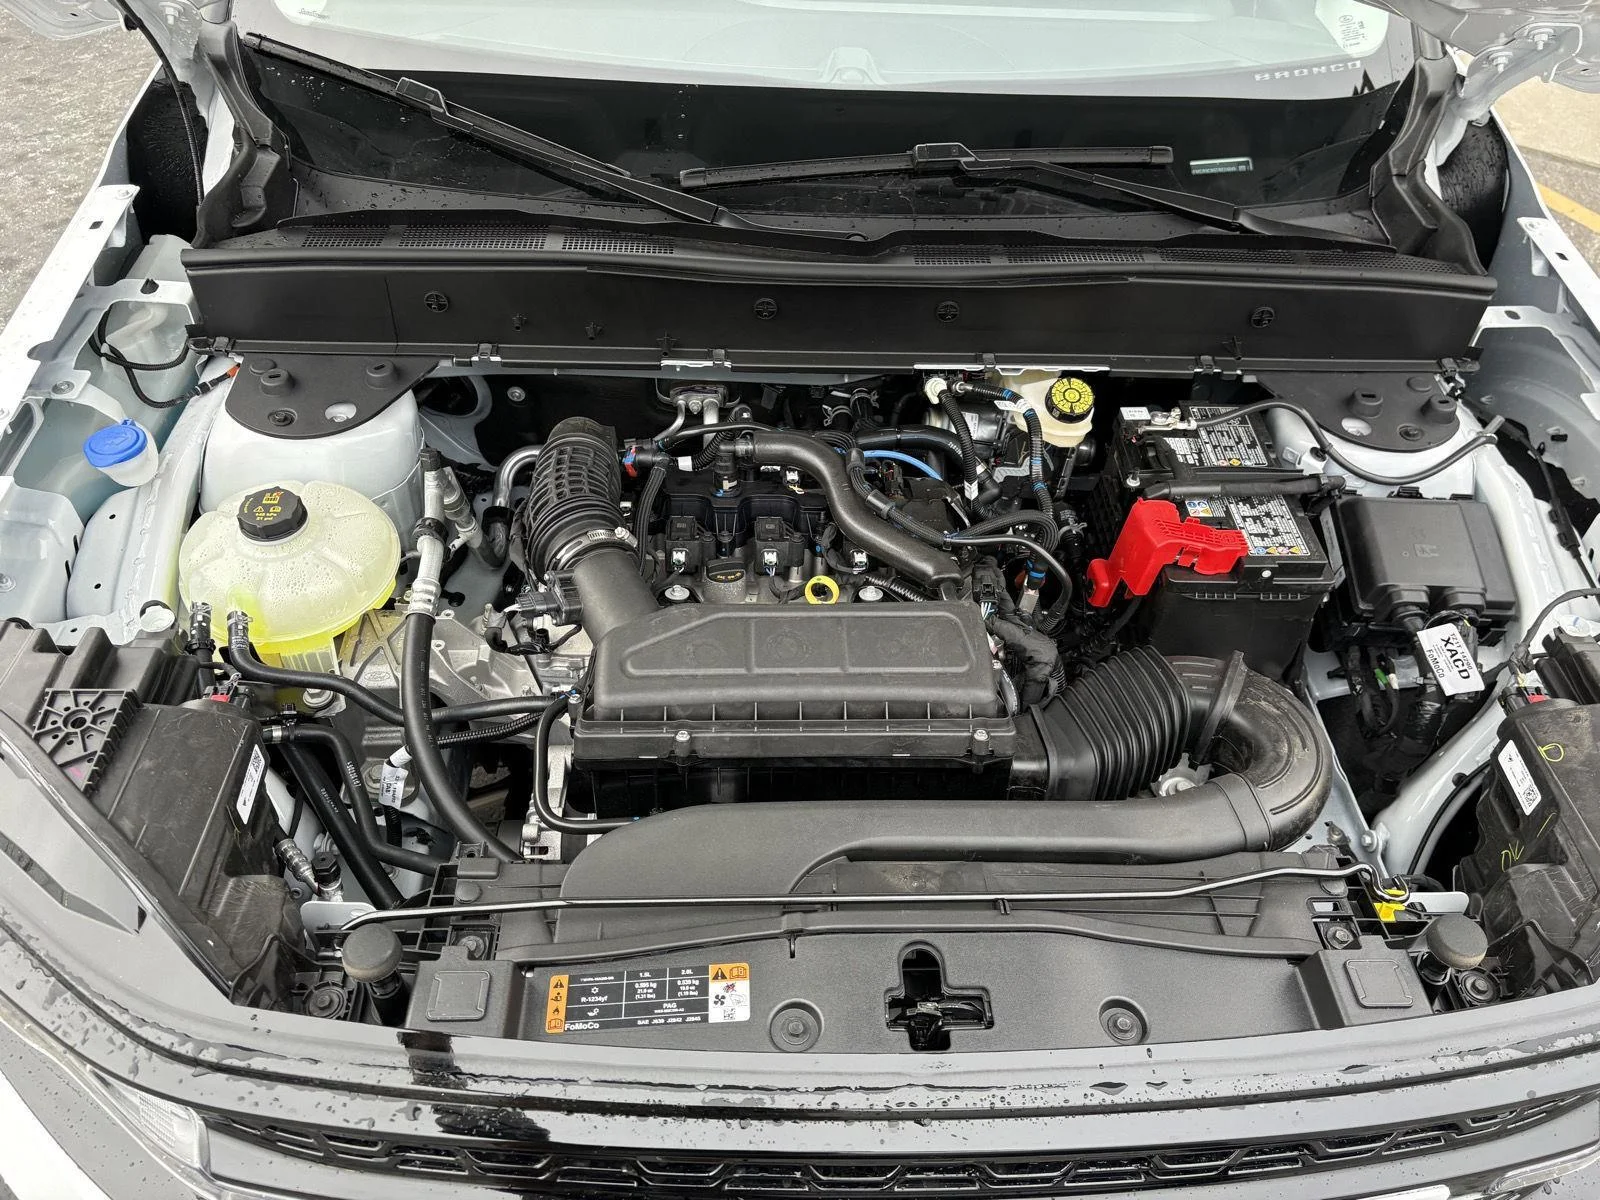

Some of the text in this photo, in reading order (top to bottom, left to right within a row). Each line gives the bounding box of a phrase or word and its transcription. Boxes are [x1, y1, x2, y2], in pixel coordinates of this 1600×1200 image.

[1254, 60, 1361, 81] BRONCO
[1426, 648, 1446, 679] FoMoCo
[1440, 636, 1471, 680] XACD
[580, 995, 608, 1003] R-1234yf
[564, 1021, 600, 1031] FoMoCo
